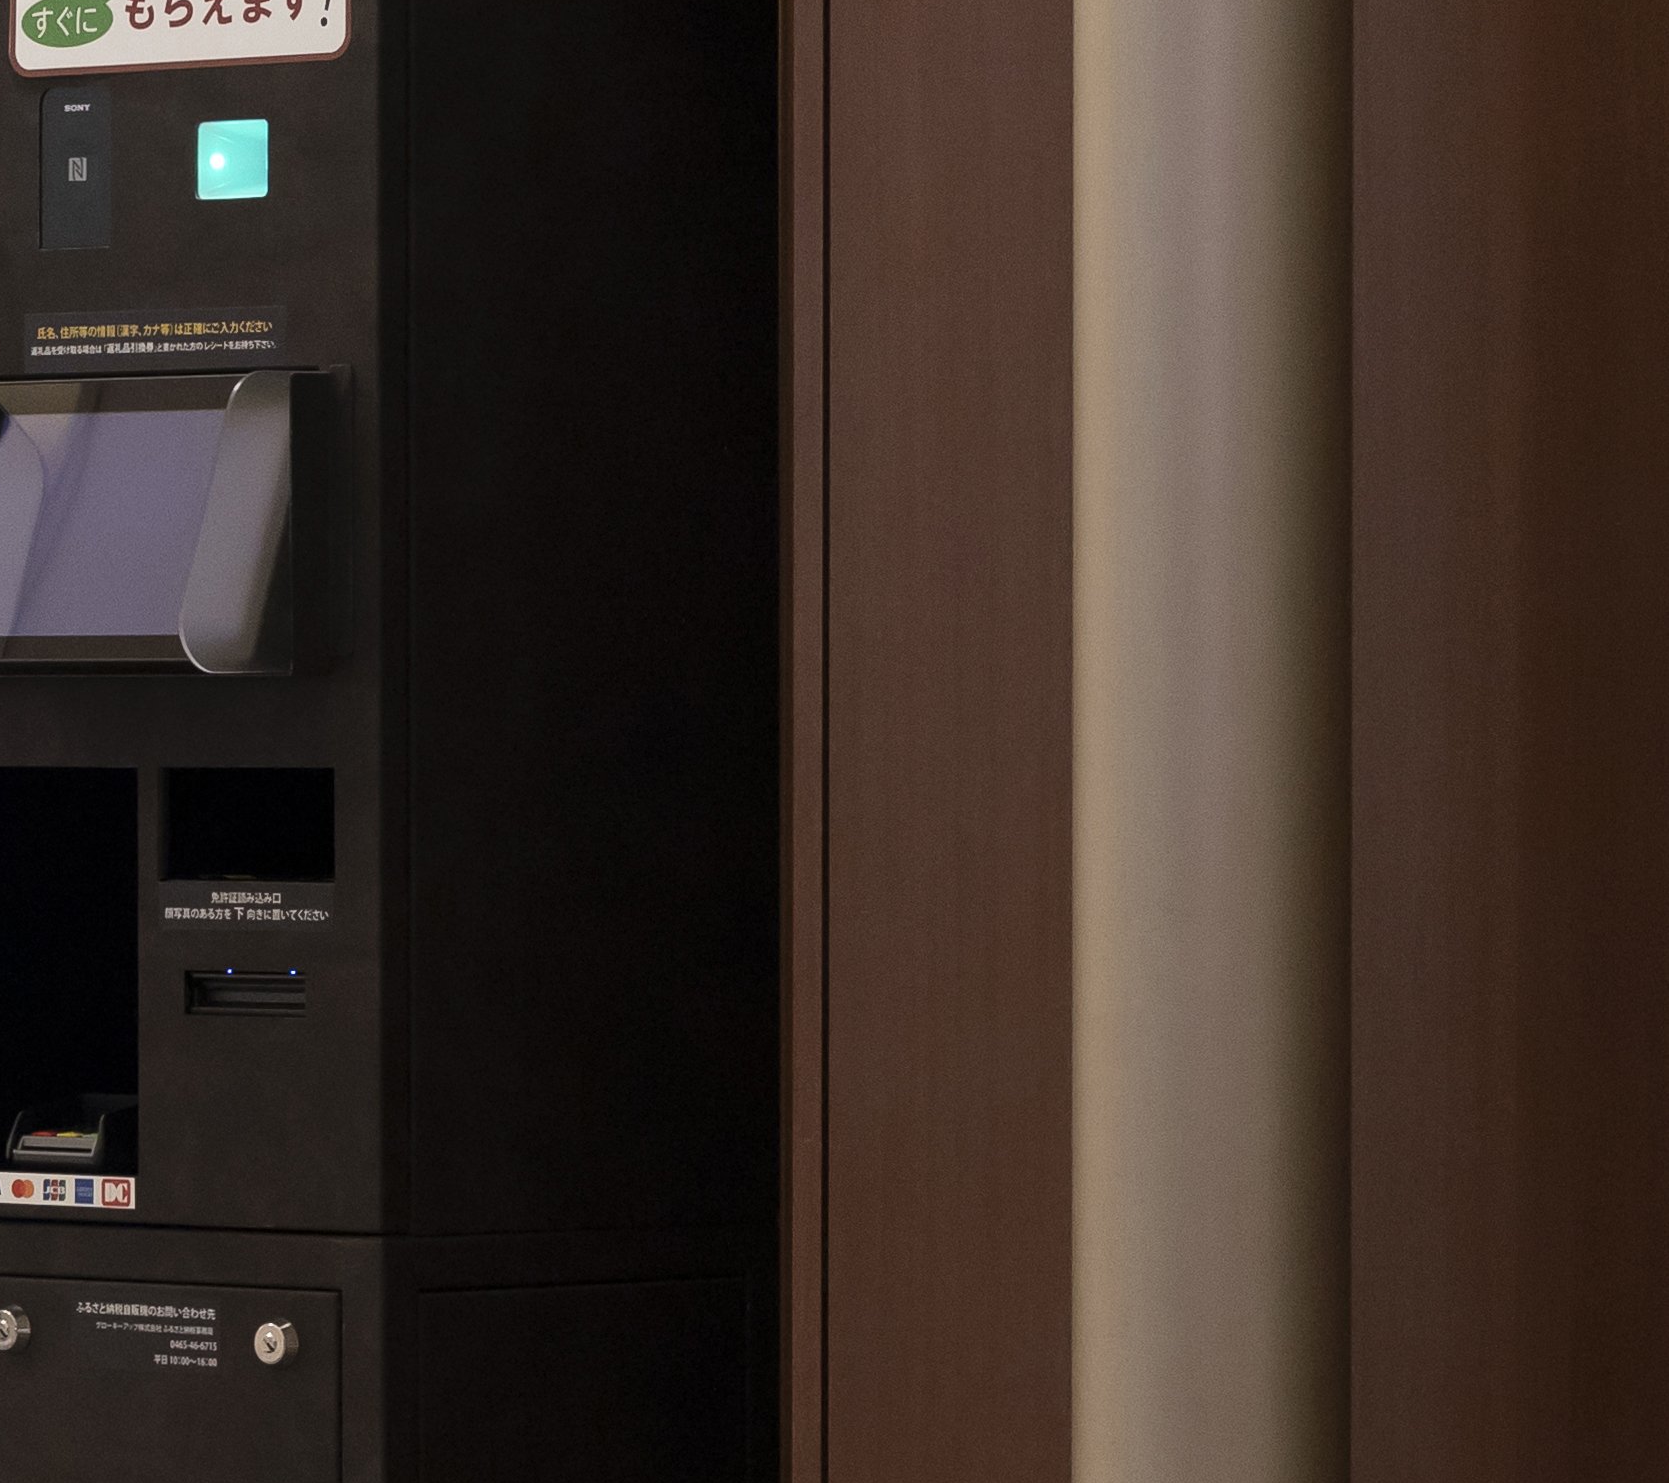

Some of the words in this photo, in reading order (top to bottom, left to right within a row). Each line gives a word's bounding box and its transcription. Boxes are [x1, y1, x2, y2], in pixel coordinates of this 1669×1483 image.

[31, 4, 98, 38] すぐに
[64, 104, 91, 112] SONY
[234, 907, 244, 920] 下
